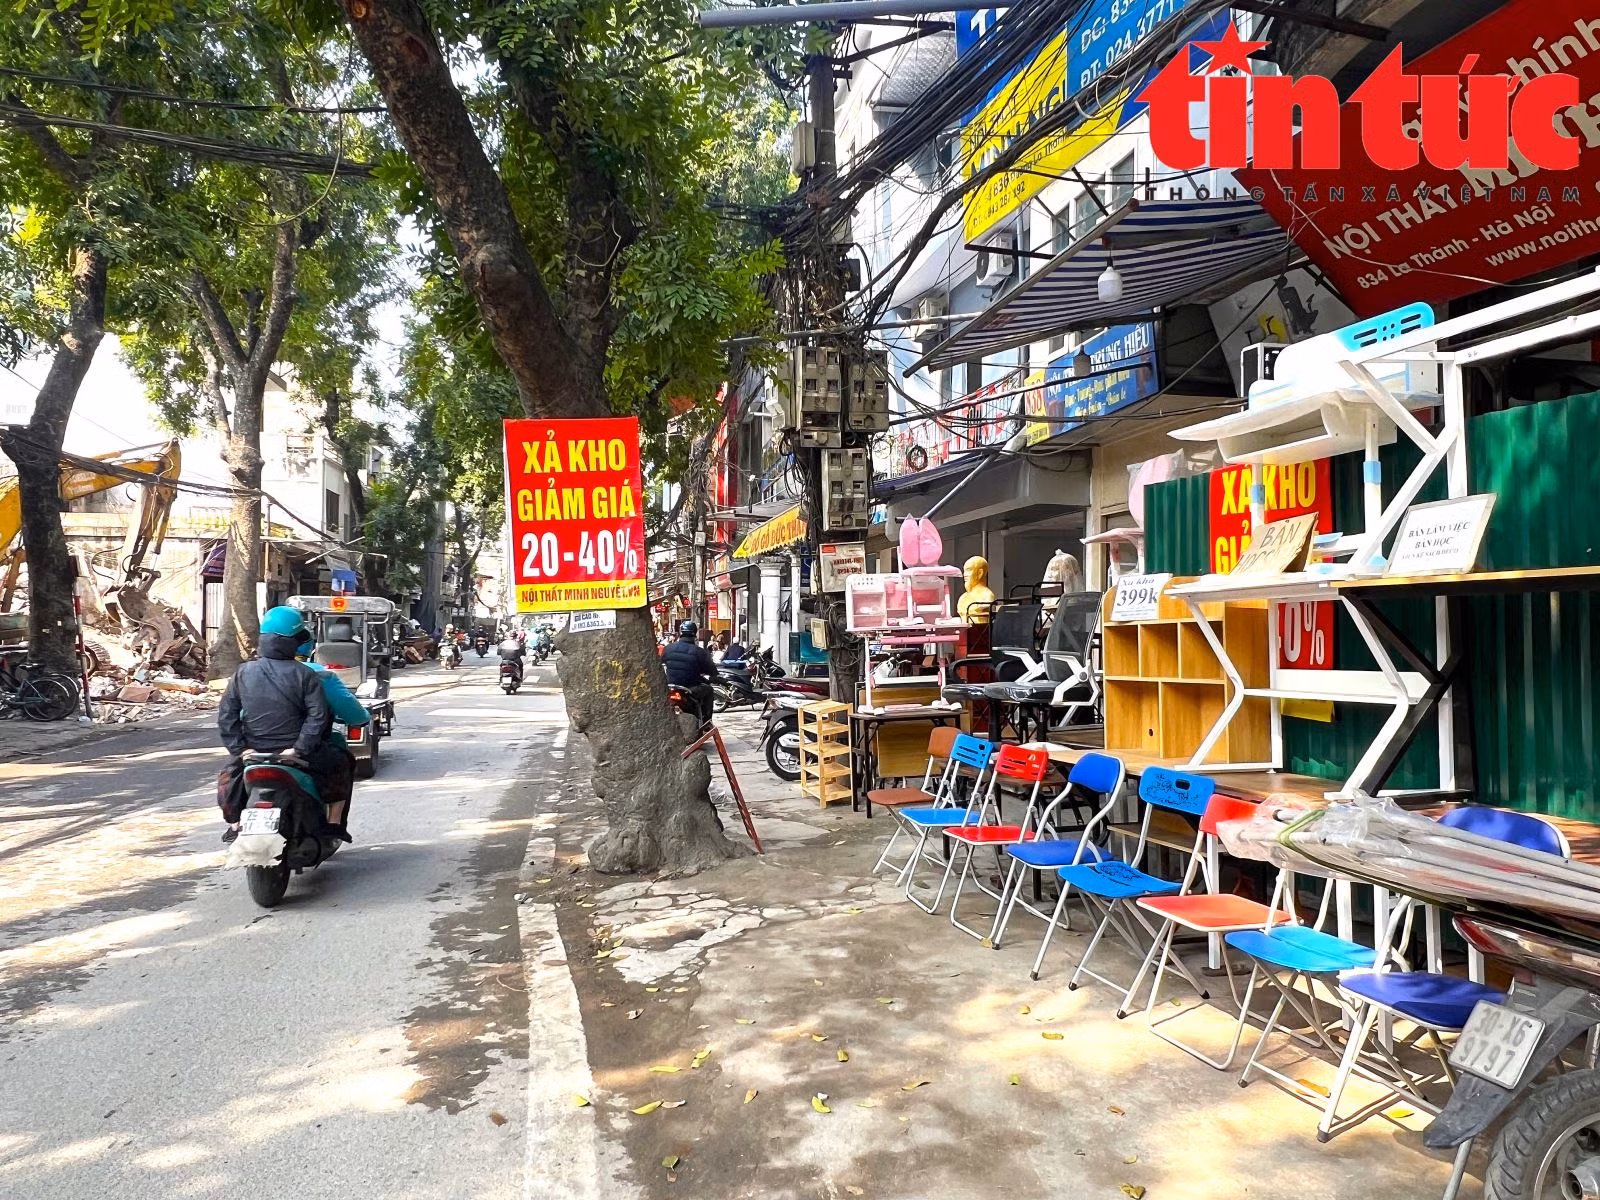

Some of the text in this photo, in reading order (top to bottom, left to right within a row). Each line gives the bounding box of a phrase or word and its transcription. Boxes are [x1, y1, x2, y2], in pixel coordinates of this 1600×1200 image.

[1105, 29, 1133, 69] 024
[1323, 222, 1380, 260] NỘI
[1376, 180, 1459, 236] THẤT
[1356, 269, 1389, 289] 834
[1410, 237, 1470, 269] Thành
[1479, 220, 1514, 242] Hà
[1513, 202, 1556, 230] Nội
[1123, 322, 1150, 359] HIẾU
[522, 429, 626, 474] XẢ KHO
[517, 477, 637, 522] GIẢM GIÁ
[1262, 461, 1316, 511] KHO
[521, 590, 538, 607] NỘI
[540, 585, 563, 602] THẤT
[564, 587, 589, 601] MINH
[1116, 587, 1158, 607] 399k
[1459, 1036, 1516, 1078] 9797
